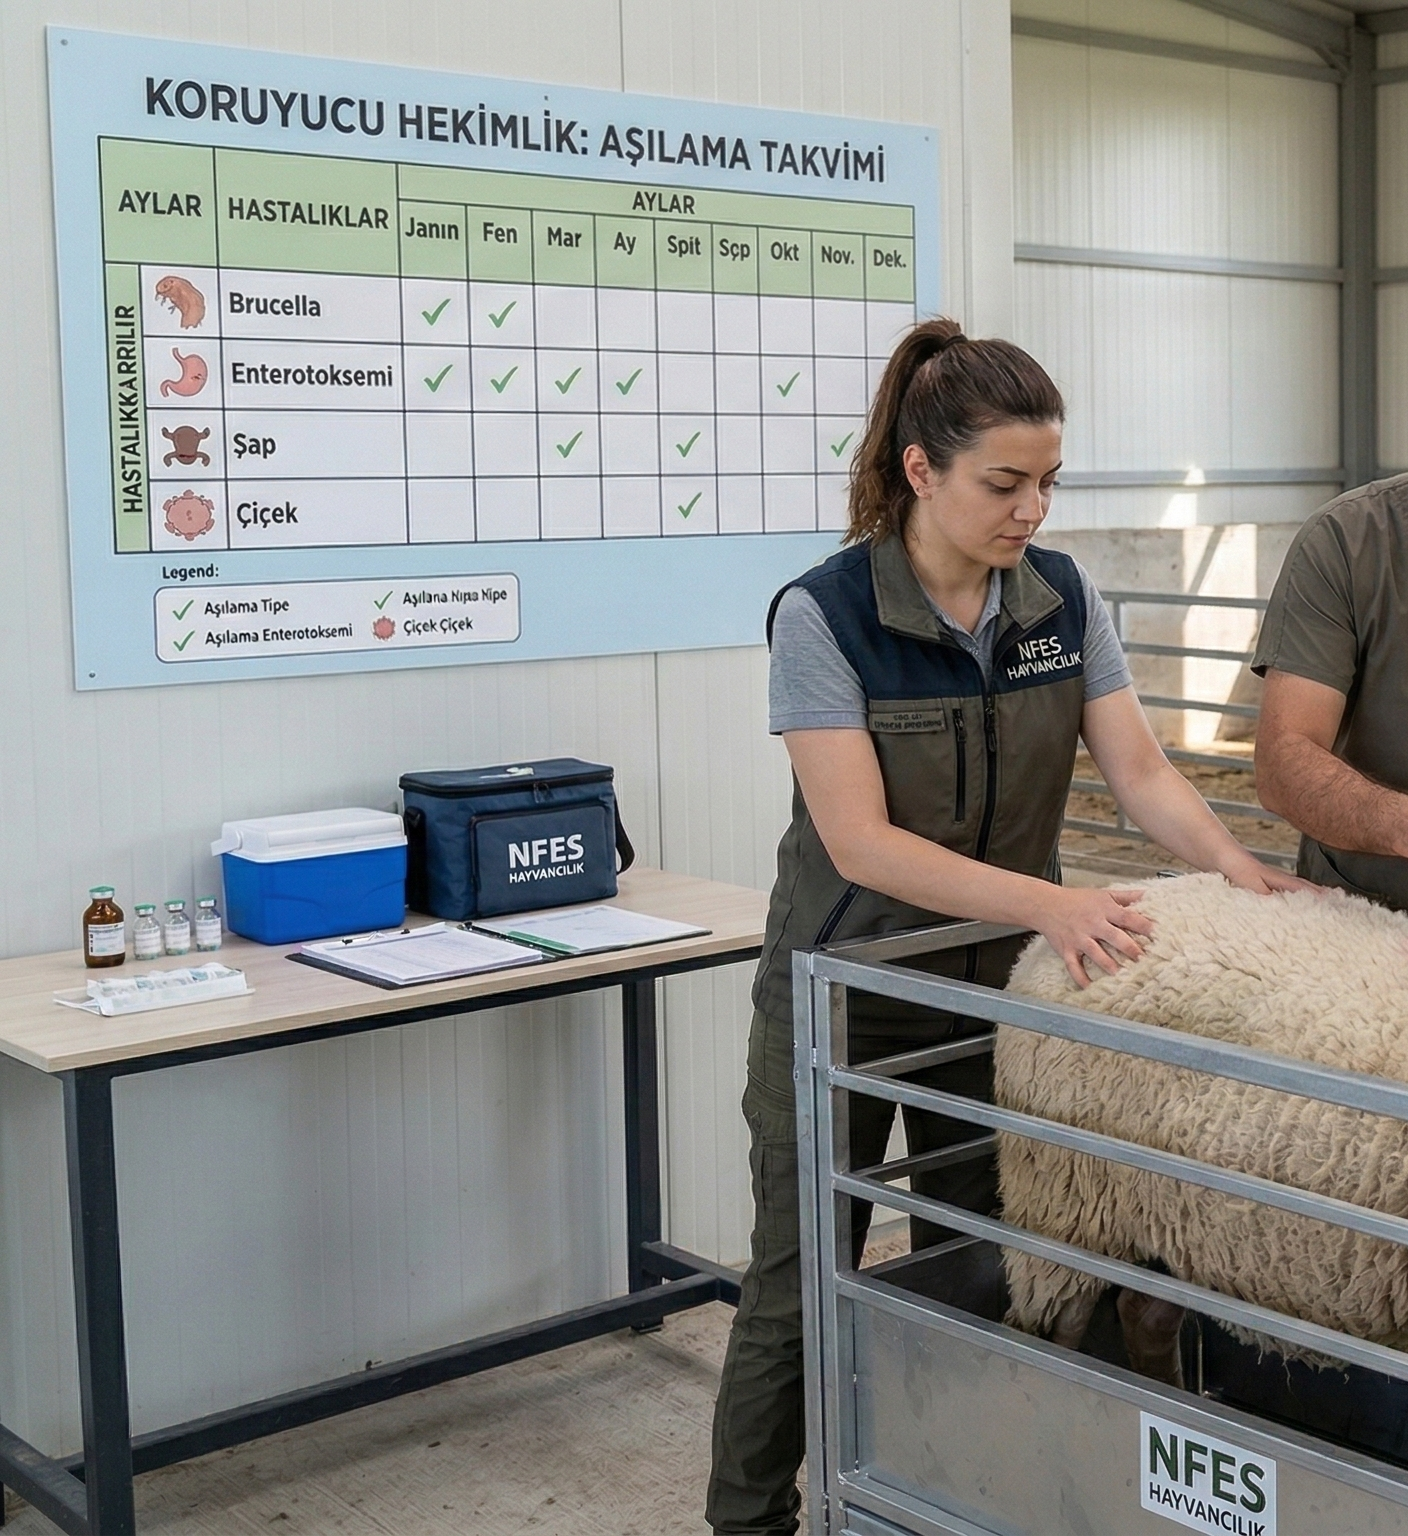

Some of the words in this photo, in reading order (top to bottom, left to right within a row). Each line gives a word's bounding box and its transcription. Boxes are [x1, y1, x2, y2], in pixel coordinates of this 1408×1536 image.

[146, 77, 384, 136] KORUYUCU
[399, 102, 588, 156] HEKİMLİK:
[600, 124, 751, 171] AŞILAMA
[760, 140, 885, 182] TAKVİMİ
[118, 190, 202, 217] AYLAR
[228, 198, 389, 230] HASTALIKLAR
[632, 191, 695, 215] AYLAR
[483, 222, 518, 244] Fen
[547, 227, 582, 248] Mar
[613, 232, 637, 255] Ay
[667, 235, 701, 257] Spit
[719, 238, 751, 261] Sçp
[770, 242, 800, 262] Okt
[821, 246, 855, 265] Nov.
[873, 249, 907, 268] Dek.
[229, 292, 321, 317] Brucella
[232, 363, 393, 387] Enterotoksemi
[232, 433, 276, 459] Şap
[236, 501, 299, 528] Çiçek
[162, 563, 219, 582] Legend:
[204, 600, 258, 618] Aşılama
[205, 630, 259, 648] Aşılama
[263, 623, 353, 642] Enterotoksemi
[403, 619, 438, 636] Çiçek
[440, 617, 474, 634] Çiçek
[1017, 635, 1062, 661] NFES
[1007, 651, 1082, 680] HAYVANCILIK
[508, 834, 584, 868] NFES
[509, 862, 584, 883] HAYVANCILIK
[1149, 1426, 1266, 1513] NFES
[1149, 1481, 1266, 1536] HAYVANCILIK
